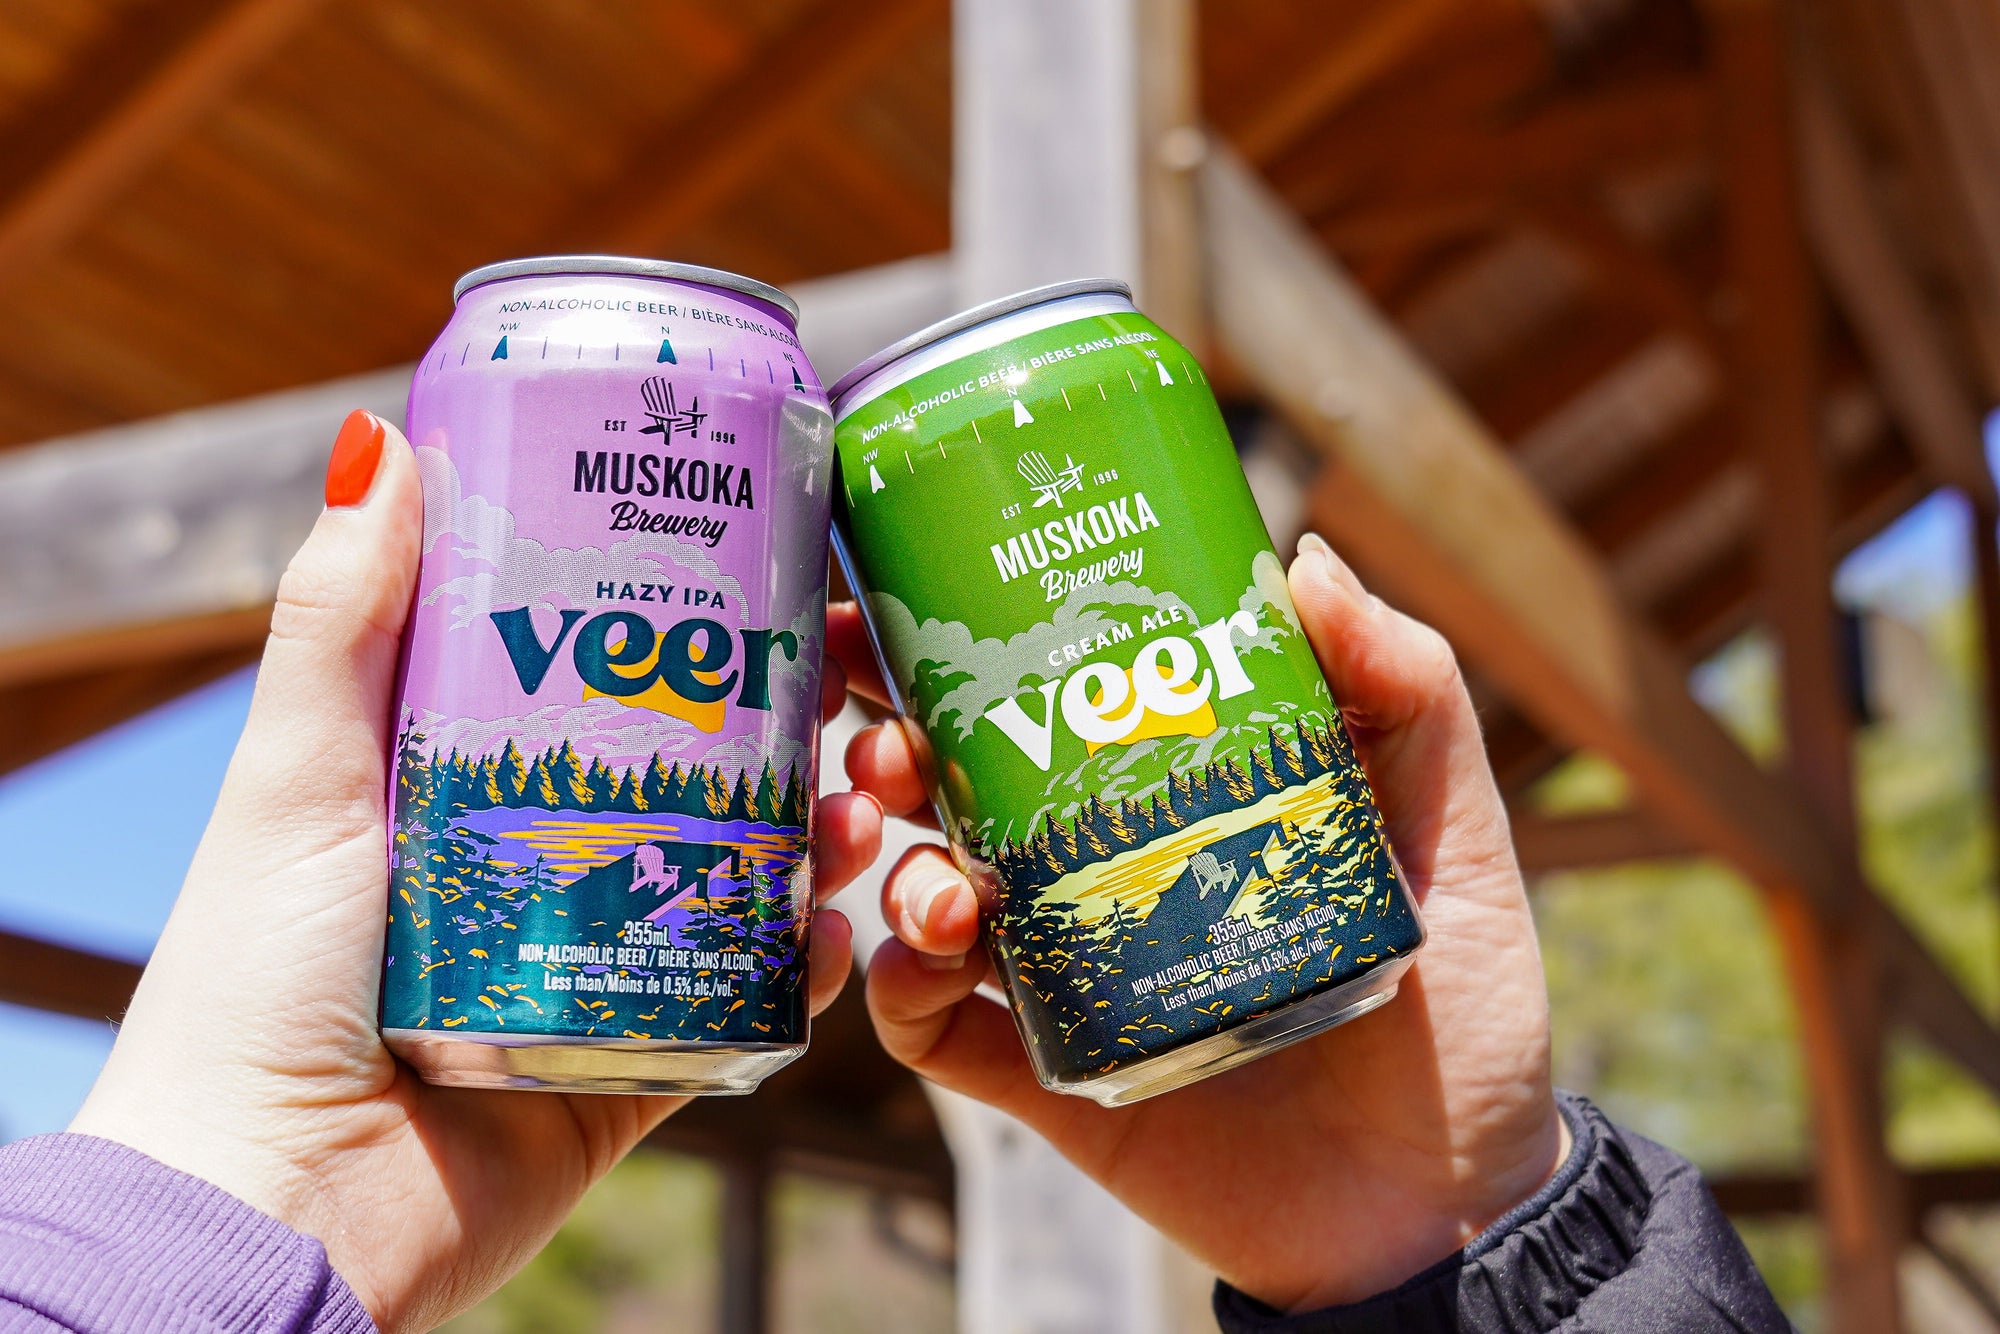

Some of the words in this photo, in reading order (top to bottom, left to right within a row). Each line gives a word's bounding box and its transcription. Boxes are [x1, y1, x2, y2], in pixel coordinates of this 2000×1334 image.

[499, 299, 632, 314] NON-ALCOHOLIC
[638, 302, 679, 317] BEER
[682, 306, 687, 318] /
[691, 308, 734, 327] BIÈRE
[735, 317, 768, 337] SANS
[499, 322, 521, 332] NW
[661, 325, 670, 335] N
[782, 351, 796, 364] NE
[1144, 349, 1160, 359] NE
[862, 380, 976, 445] NON-ALCOHOLIC
[978, 365, 1018, 388] BEER
[1030, 346, 1077, 369] BIÈRE
[1075, 338, 1114, 355] SANS
[1113, 331, 1158, 347] ALCOOL
[1006, 386, 1017, 398] N
[604, 419, 627, 432] EST
[710, 430, 737, 445] 1996
[862, 447, 879, 466] NW
[573, 450, 755, 511] MUSKOKA
[1092, 468, 1119, 487] 1996
[608, 500, 729, 549] Brewery
[1001, 502, 1022, 521] EST
[989, 491, 1161, 584] MUSKOKA
[1040, 546, 1145, 603] Brewery
[596, 580, 675, 604] HAZY
[683, 587, 727, 610] IPA
[1047, 622, 1135, 668] CREAM
[1141, 604, 1184, 635] ALE
[489, 606, 800, 712] veer
[984, 609, 1260, 772] veer
[622, 920, 671, 947] 355mL
[1208, 914, 1256, 946] 355mL
[517, 943, 614, 966] NON-ALCOHOLIC
[616, 947, 647, 967] BEER
[648, 948, 657, 968] /
[658, 946, 690, 969] BIÈRE
[692, 951, 720, 970] SANS
[721, 953, 755, 972] ALCOOL
[1131, 953, 1212, 997] NON-ALCOHOLIC
[1213, 942, 1240, 966] BEER
[1241, 935, 1247, 957] /
[1247, 928, 1279, 952] BIÈRE
[1277, 918, 1305, 938] SANS
[1305, 903, 1340, 931] ALCOOL
[544, 971, 572, 991] Less
[575, 973, 643, 995] than/Moins
[646, 975, 660, 995] de
[663, 976, 691, 996] 0.5%
[1161, 993, 1188, 1012] Less
[1187, 970, 1247, 1002] than/Moins
[1247, 962, 1262, 978] de
[1262, 951, 1290, 972] 0.5%
